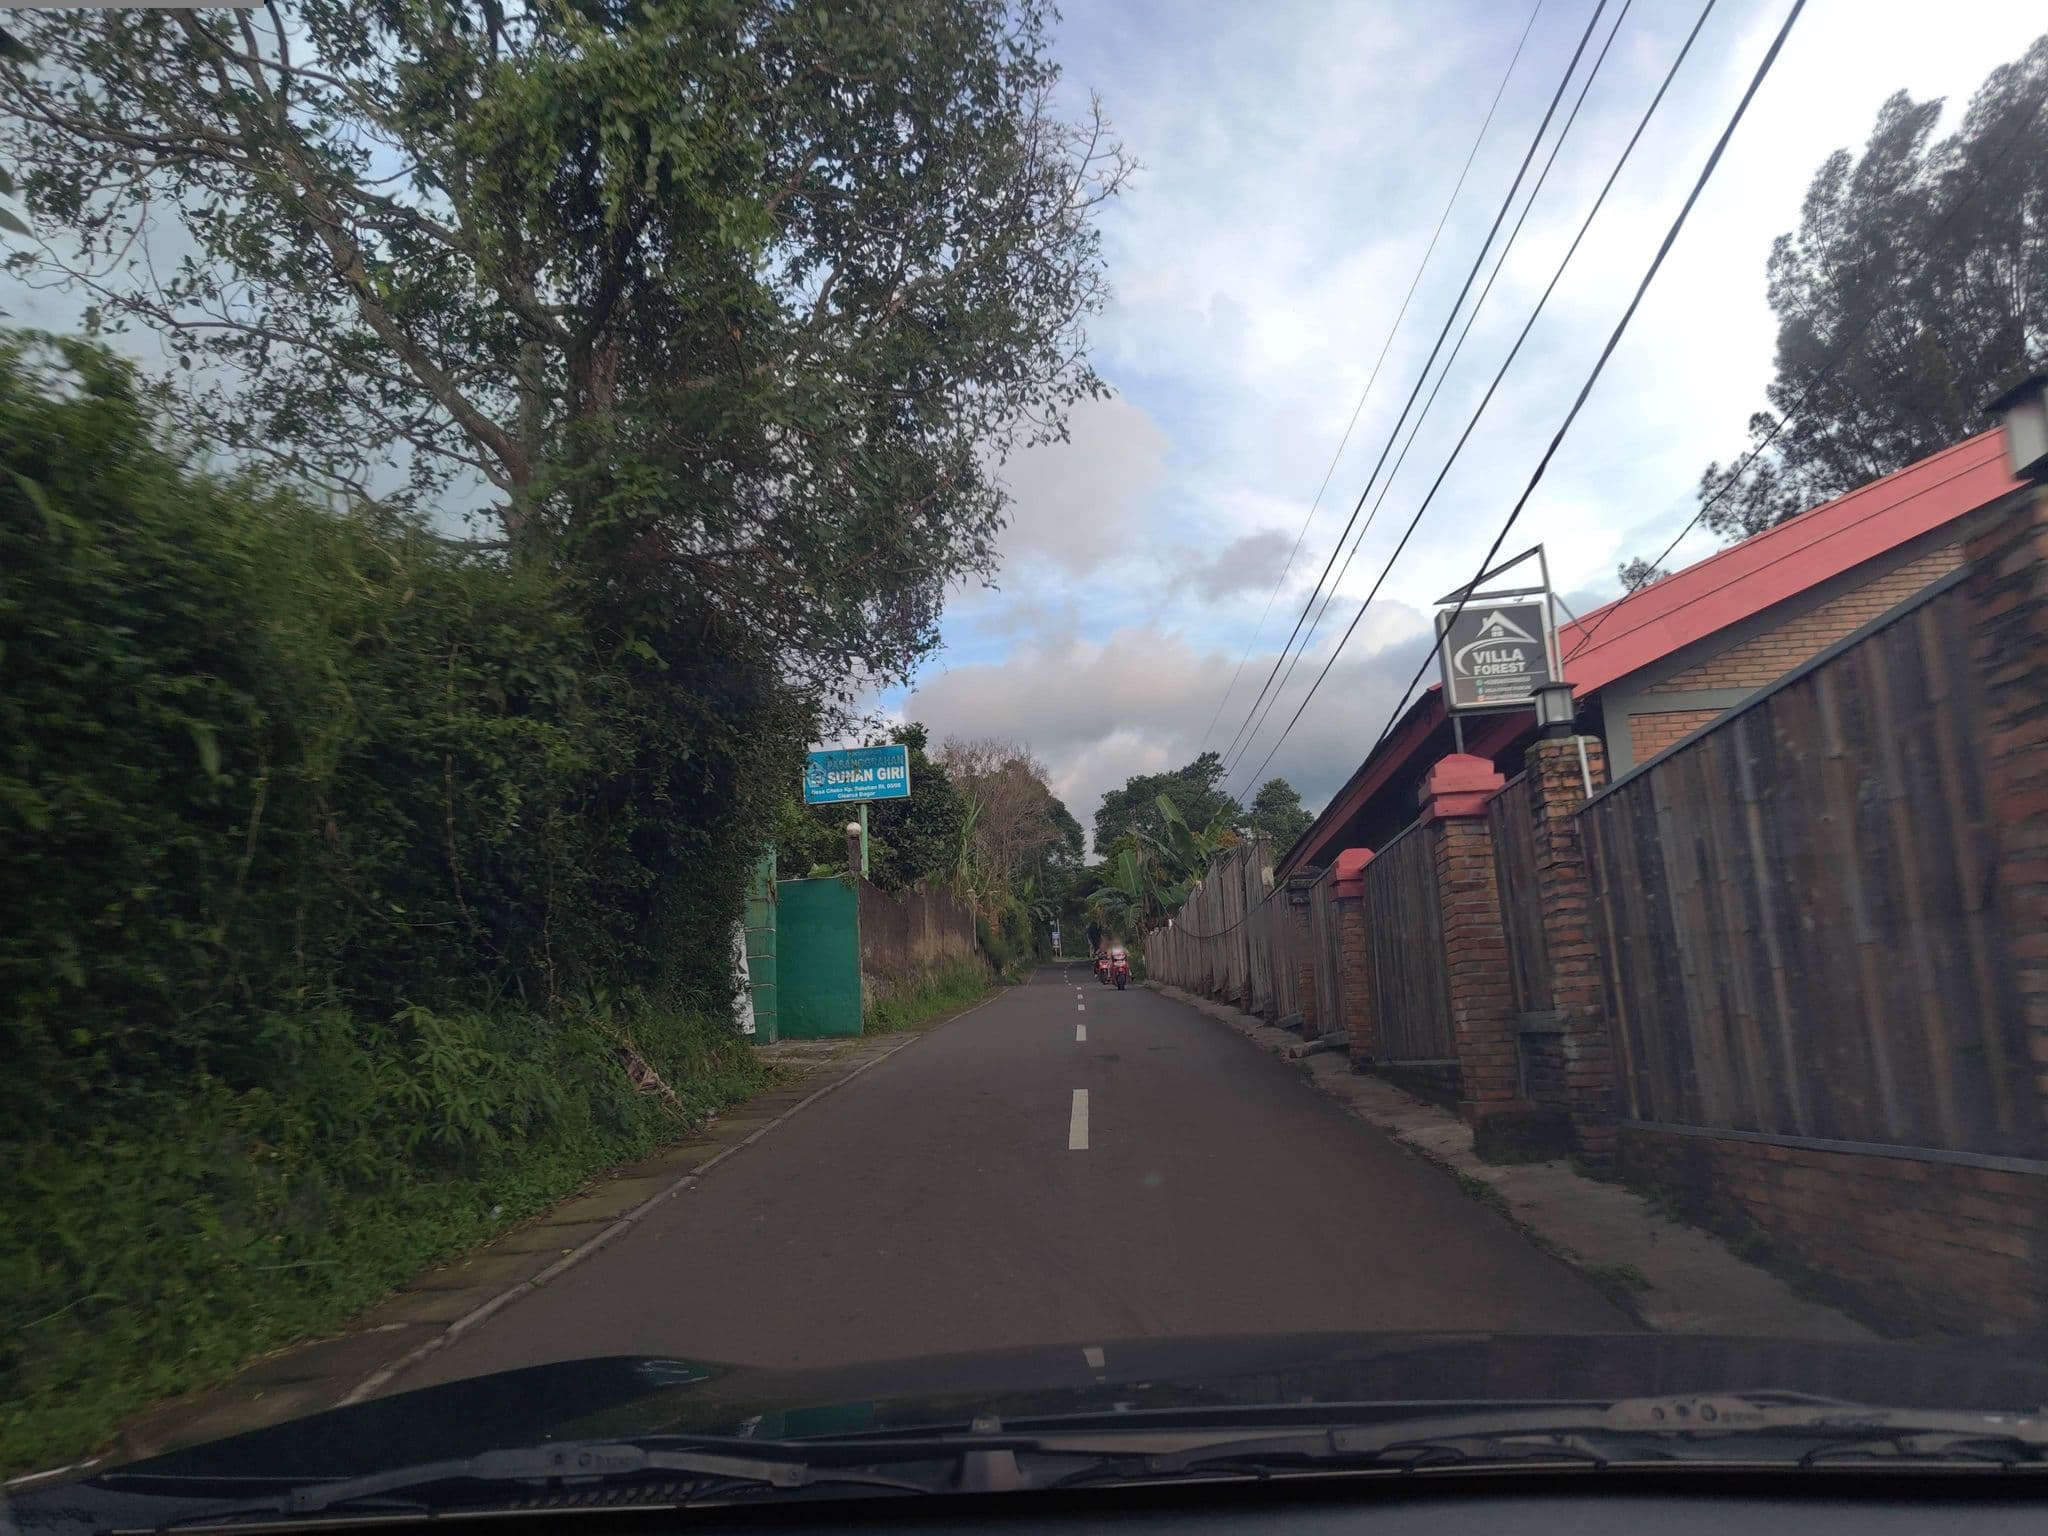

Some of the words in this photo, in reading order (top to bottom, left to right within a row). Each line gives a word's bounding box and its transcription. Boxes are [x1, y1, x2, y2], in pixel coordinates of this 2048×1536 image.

[1473, 648, 1525, 663] VILLA
[1474, 661, 1526, 675] FOREST
[877, 766, 904, 780] GIRI
